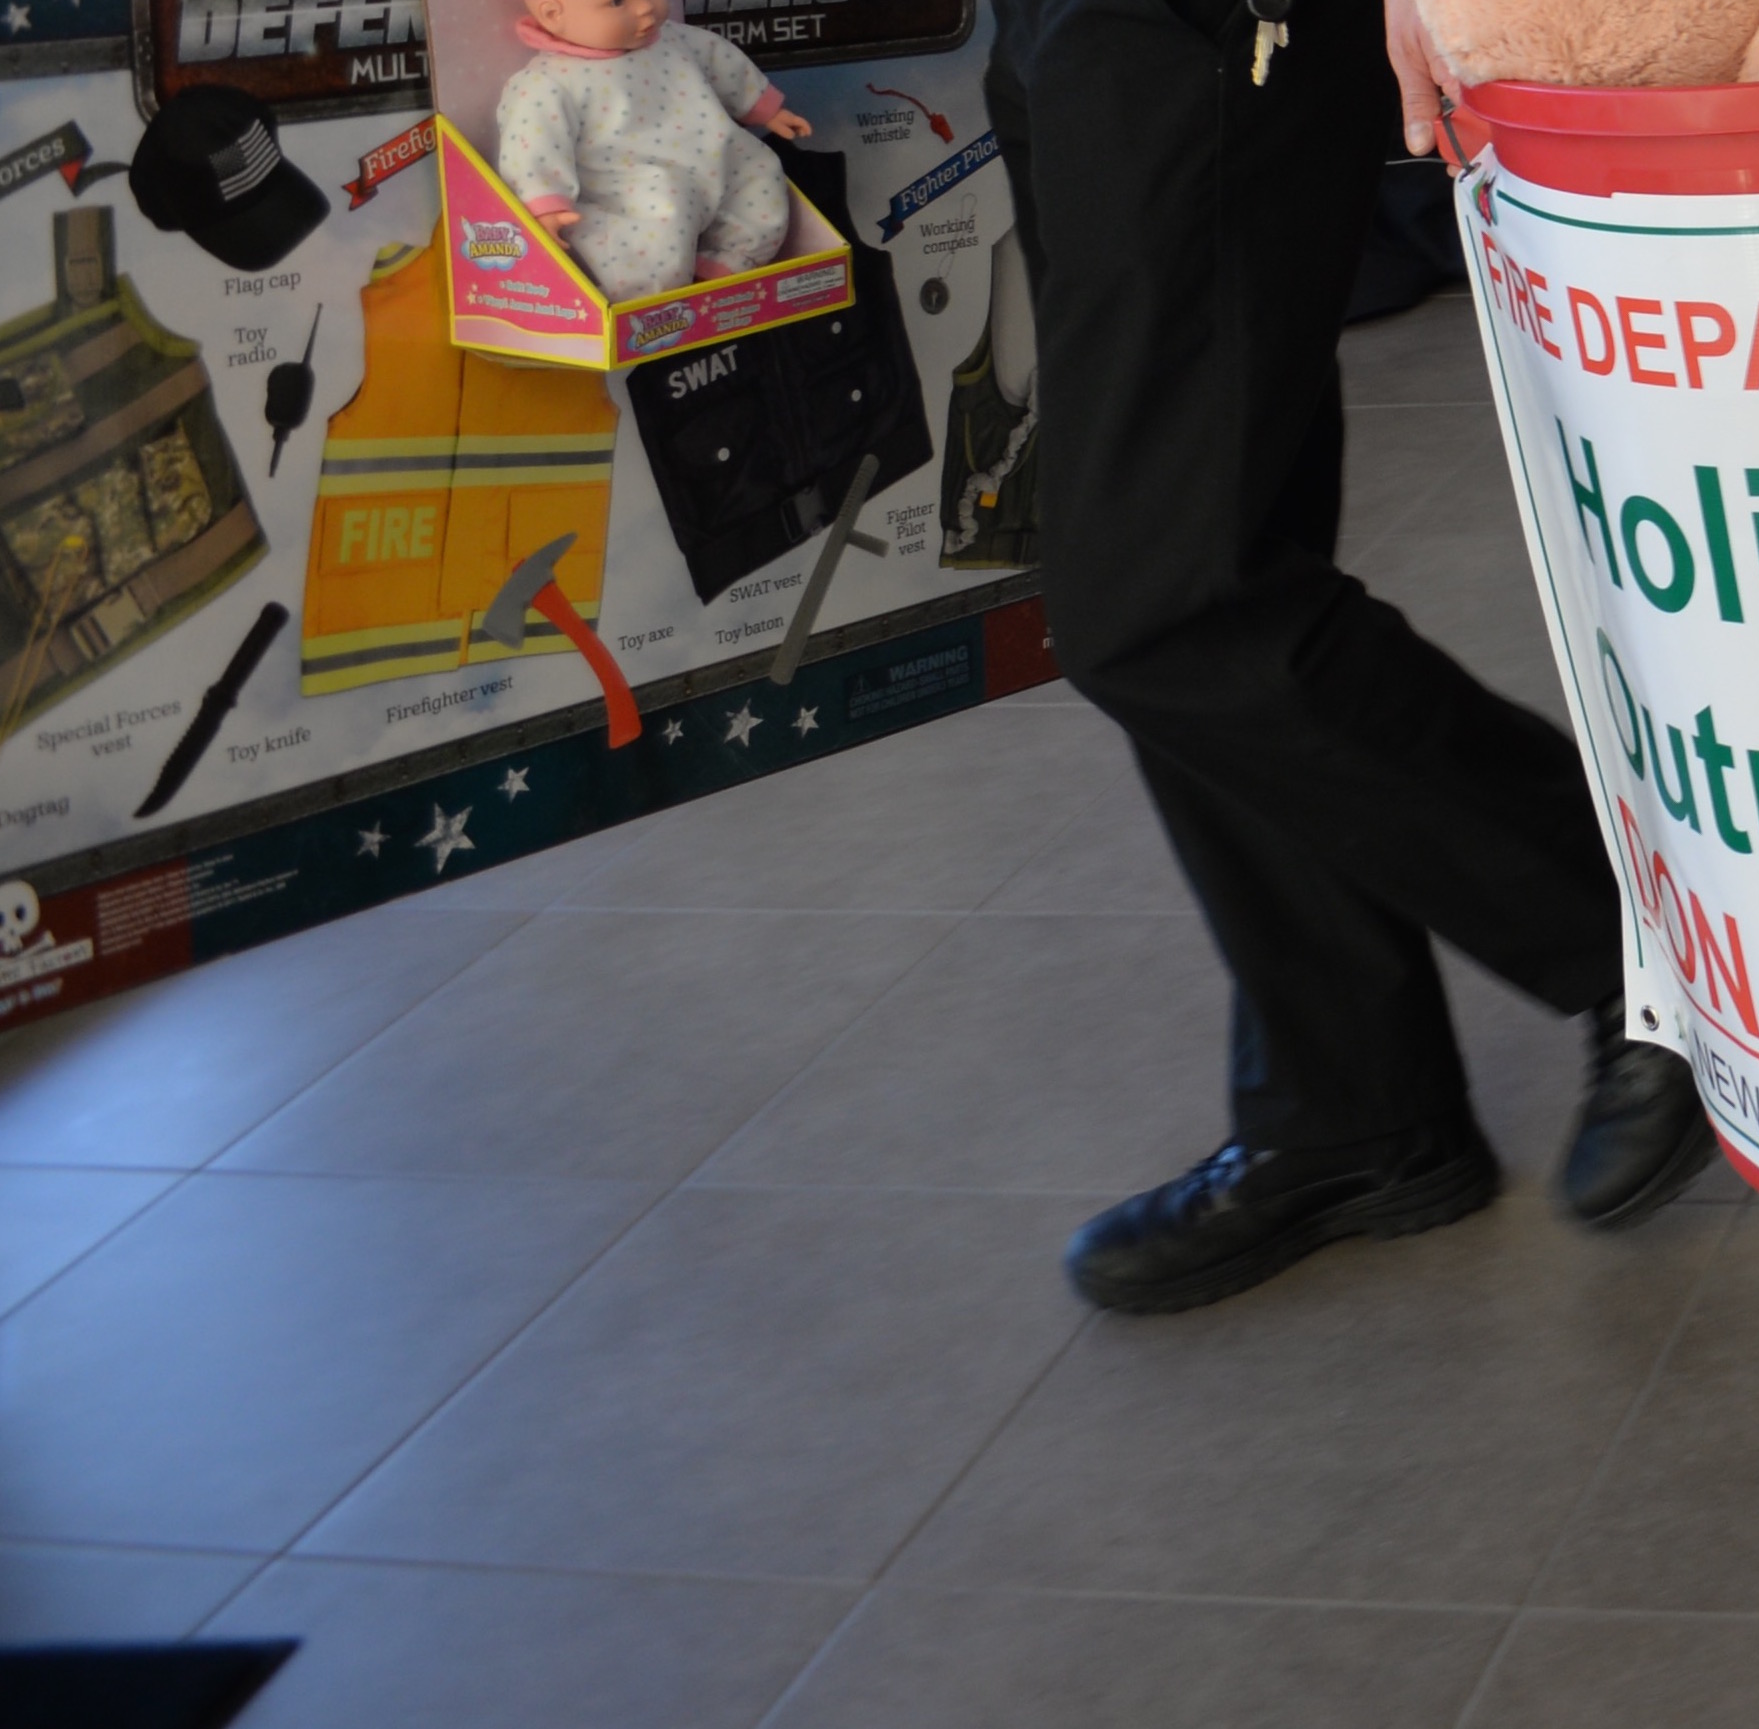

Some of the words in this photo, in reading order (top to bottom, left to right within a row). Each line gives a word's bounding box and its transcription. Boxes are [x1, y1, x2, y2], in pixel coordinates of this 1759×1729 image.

[773, 13, 827, 43] SET
[856, 109, 915, 128] Working
[861, 126, 911, 145] whistle
[899, 160, 960, 212] Fighter
[919, 214, 976, 238] Working
[469, 242, 522, 259] AMANDA
[922, 235, 979, 256] compass
[223, 277, 265, 297] Flag
[268, 272, 302, 294] cap
[1480, 226, 1562, 360] FIRE
[234, 327, 269, 347] Toy
[635, 318, 690, 349] AMANDA
[227, 343, 278, 368] radio
[667, 344, 738, 400] SWAT
[886, 502, 935, 525] Fighter
[338, 506, 438, 564] FIRE
[896, 521, 927, 540] Pilot
[898, 539, 926, 556] vest
[729, 583, 771, 604] SWAT
[771, 572, 803, 593] vest
[618, 633, 647, 653] Toy
[648, 624, 675, 642] axe
[715, 628, 743, 646] Toy
[743, 615, 785, 638] baton
[888, 644, 968, 681] WARNING
[386, 683, 477, 724] Firefighter
[479, 676, 515, 697] vest
[35, 718, 111, 753] Special
[114, 699, 182, 732] Forces
[89, 733, 134, 759] vest
[227, 742, 261, 764] Toy
[264, 726, 312, 753] knife
